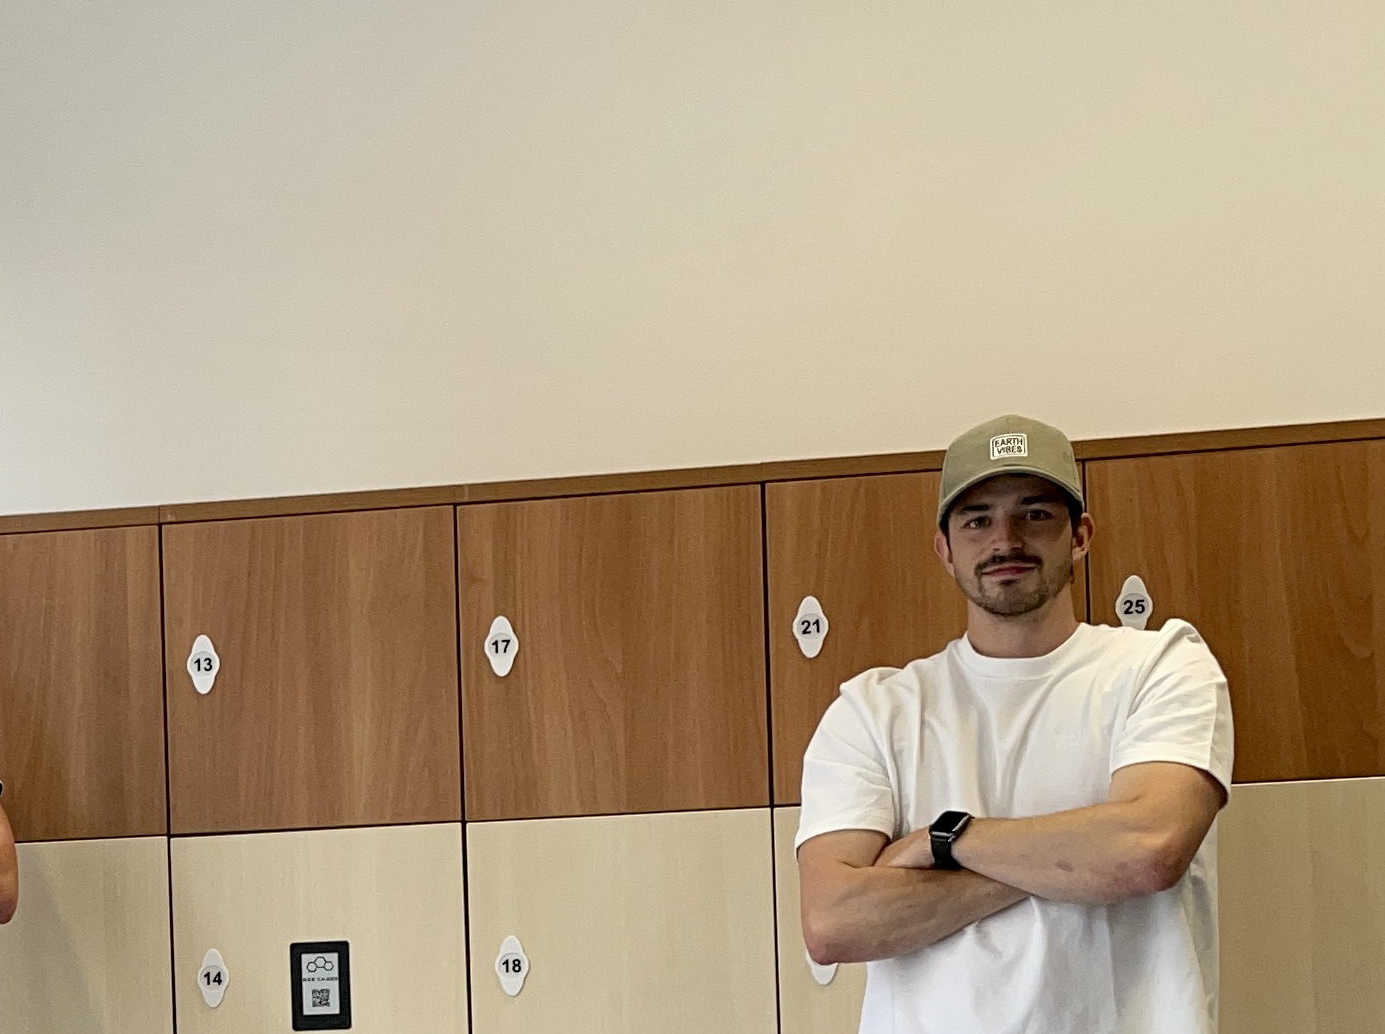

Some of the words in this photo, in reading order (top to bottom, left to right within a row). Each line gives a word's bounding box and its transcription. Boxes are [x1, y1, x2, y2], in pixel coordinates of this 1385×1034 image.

[994, 437, 1023, 448] EARTH
[996, 446, 1023, 455] VIBES
[1123, 600, 1145, 614] 25
[800, 618, 821, 635] 21
[491, 639, 511, 653] 17
[193, 657, 213, 672] 13
[502, 958, 522, 974] 18
[203, 971, 223, 986] 14
